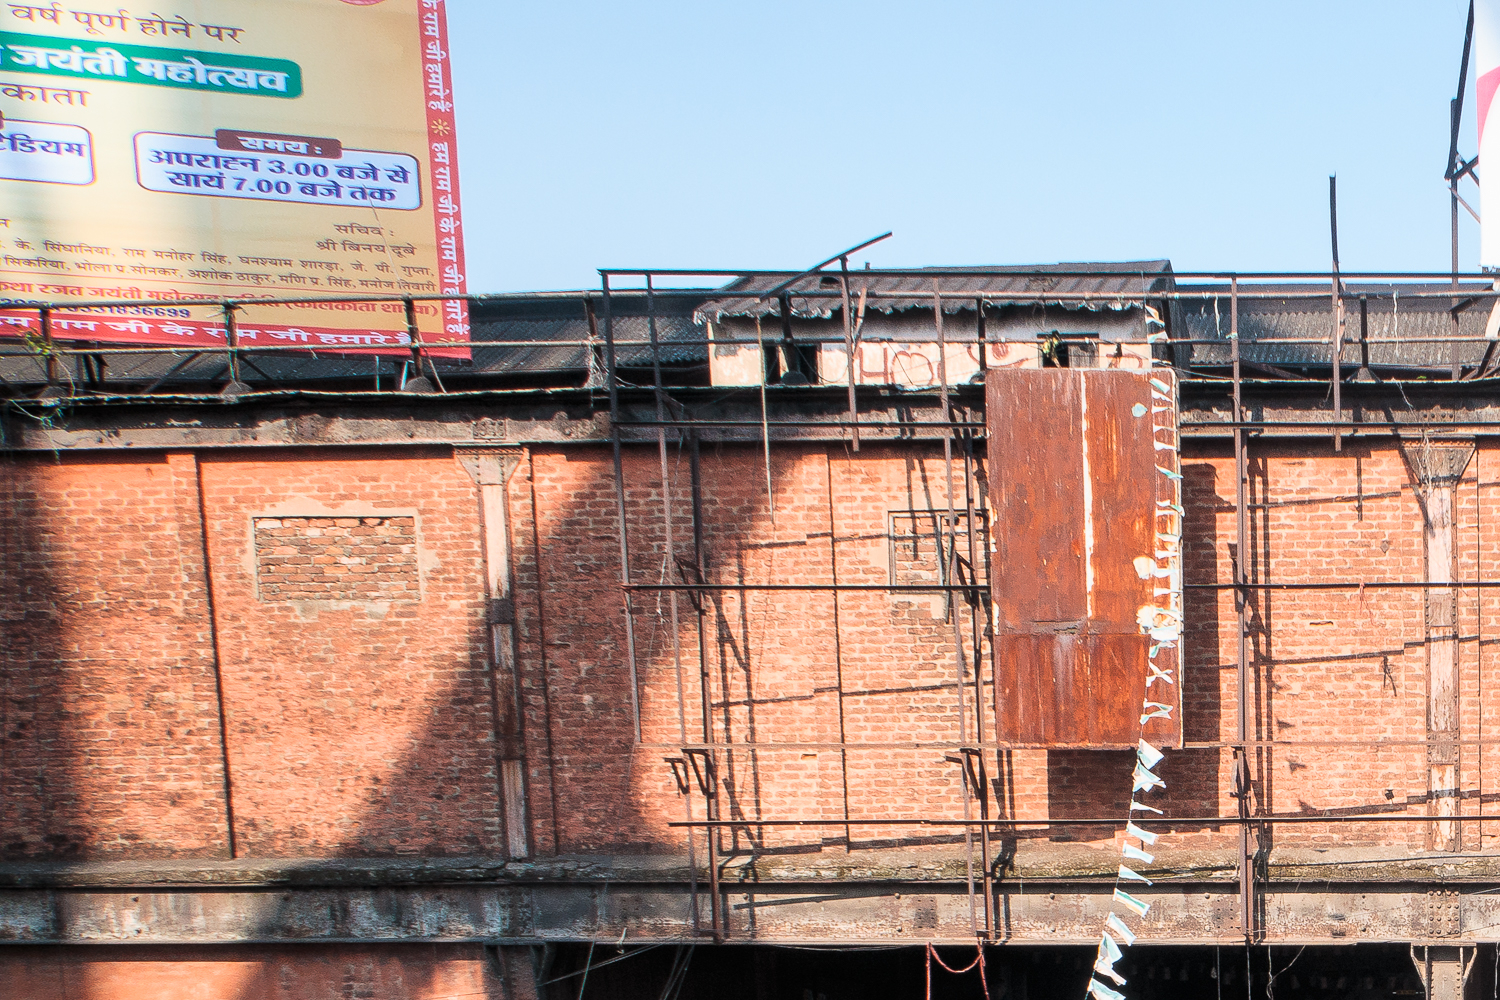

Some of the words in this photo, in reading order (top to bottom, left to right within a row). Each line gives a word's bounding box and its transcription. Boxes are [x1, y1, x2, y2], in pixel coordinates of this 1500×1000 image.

[6, 2, 64, 26] वर्ष
[69, 9, 131, 35] पूर्ण
[135, 12, 195, 38] होने
[201, 23, 245, 43] पर
[423, 12, 439, 38] राम
[425, 40, 447, 62] जी
[7, 45, 131, 78] जयंती
[131, 57, 290, 93] महोत्सव
[425, 63, 450, 99] हमारे
[237, 136, 309, 154] समय
[431, 141, 449, 165] हम
[268, 159, 329, 178] 3.00
[335, 163, 381, 182] बजे
[385, 165, 411, 184] से
[434, 166, 451, 193] राम
[165, 171, 227, 190] सायं
[234, 177, 292, 195] 7.00
[298, 180, 343, 199] बजे
[349, 186, 396, 202] तक
[437, 193, 459, 216] जी
[333, 222, 384, 237] सचिव
[439, 217, 461, 234] के
[123, 247, 146, 258] राम
[153, 248, 195, 262] मनोहर
[315, 238, 338, 252] श्री
[440, 236, 457, 262] राम
[443, 263, 465, 286] जी
[37, 283, 84, 296] रजत
[88, 286, 142, 300] जयंती
[104, 319, 153, 334] जी
[158, 321, 197, 338] के
[265, 329, 311, 342] जी
